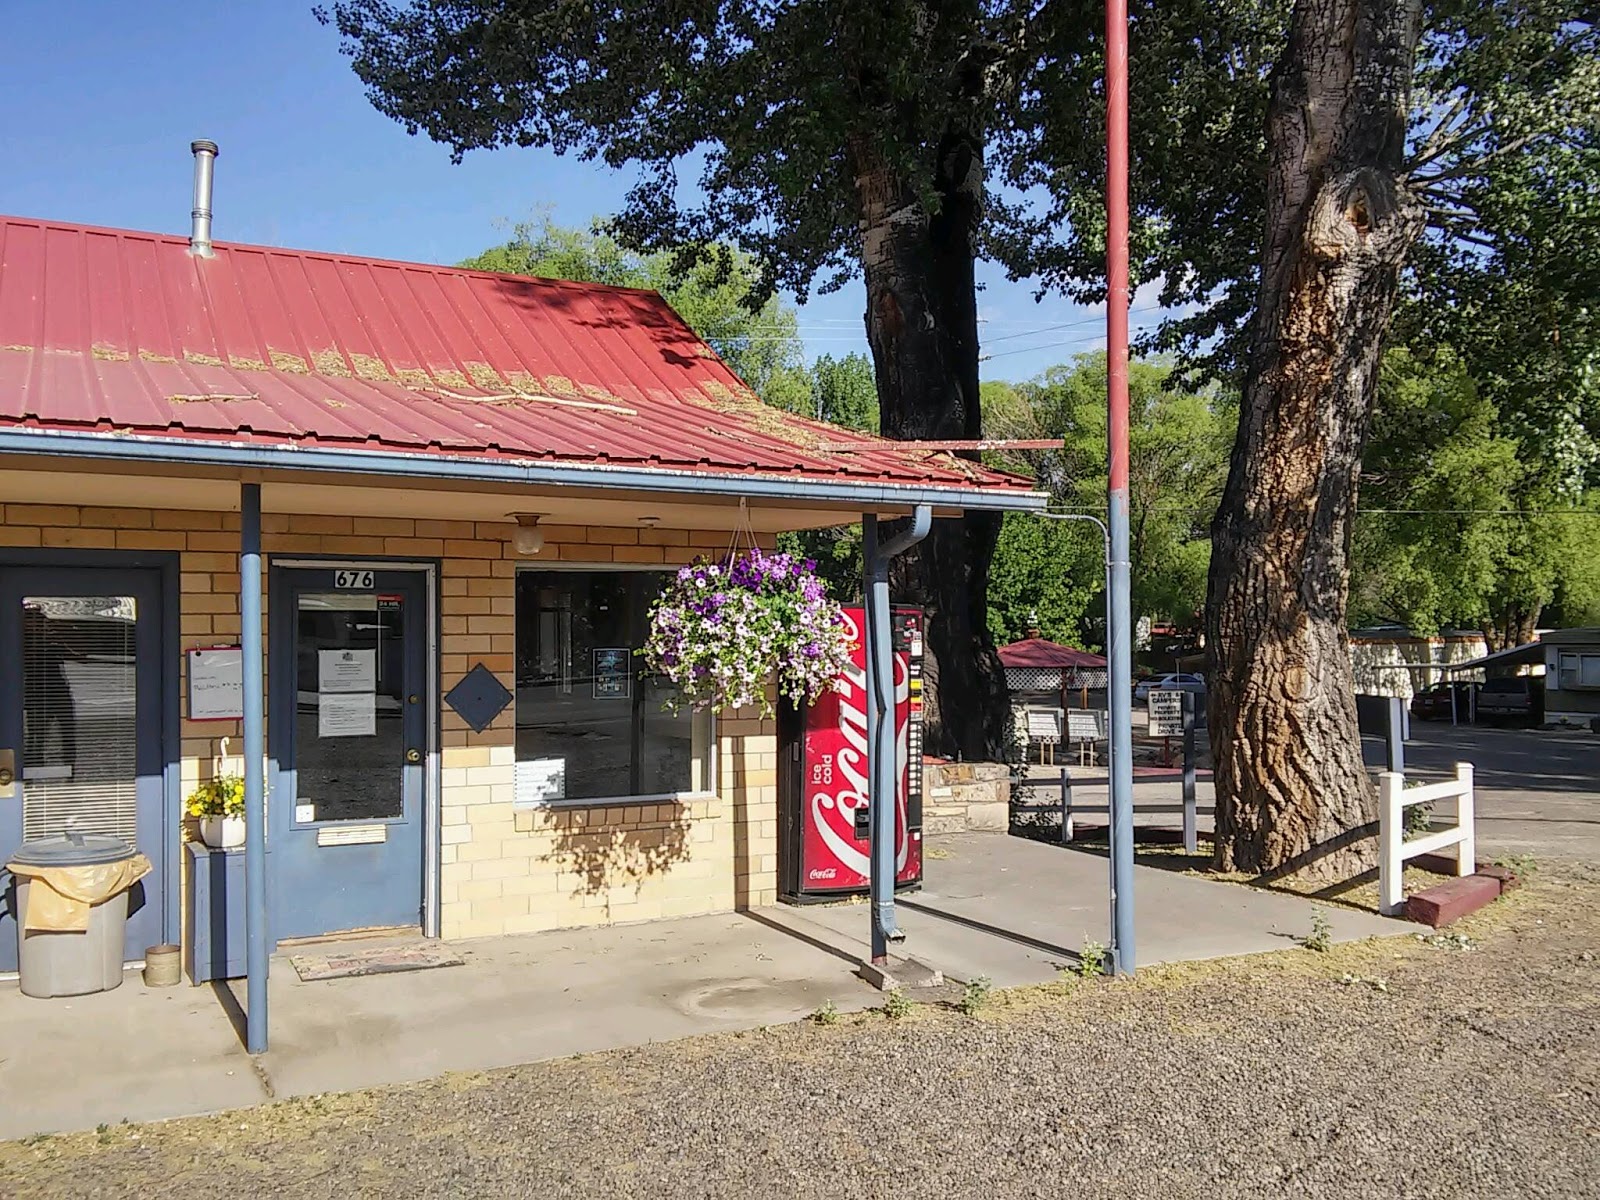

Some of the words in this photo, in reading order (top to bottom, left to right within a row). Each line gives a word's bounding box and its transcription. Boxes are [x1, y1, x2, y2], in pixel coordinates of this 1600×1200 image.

[337, 572, 372, 586] 676
[811, 764, 822, 784] ice
[822, 754, 832, 784] cold
